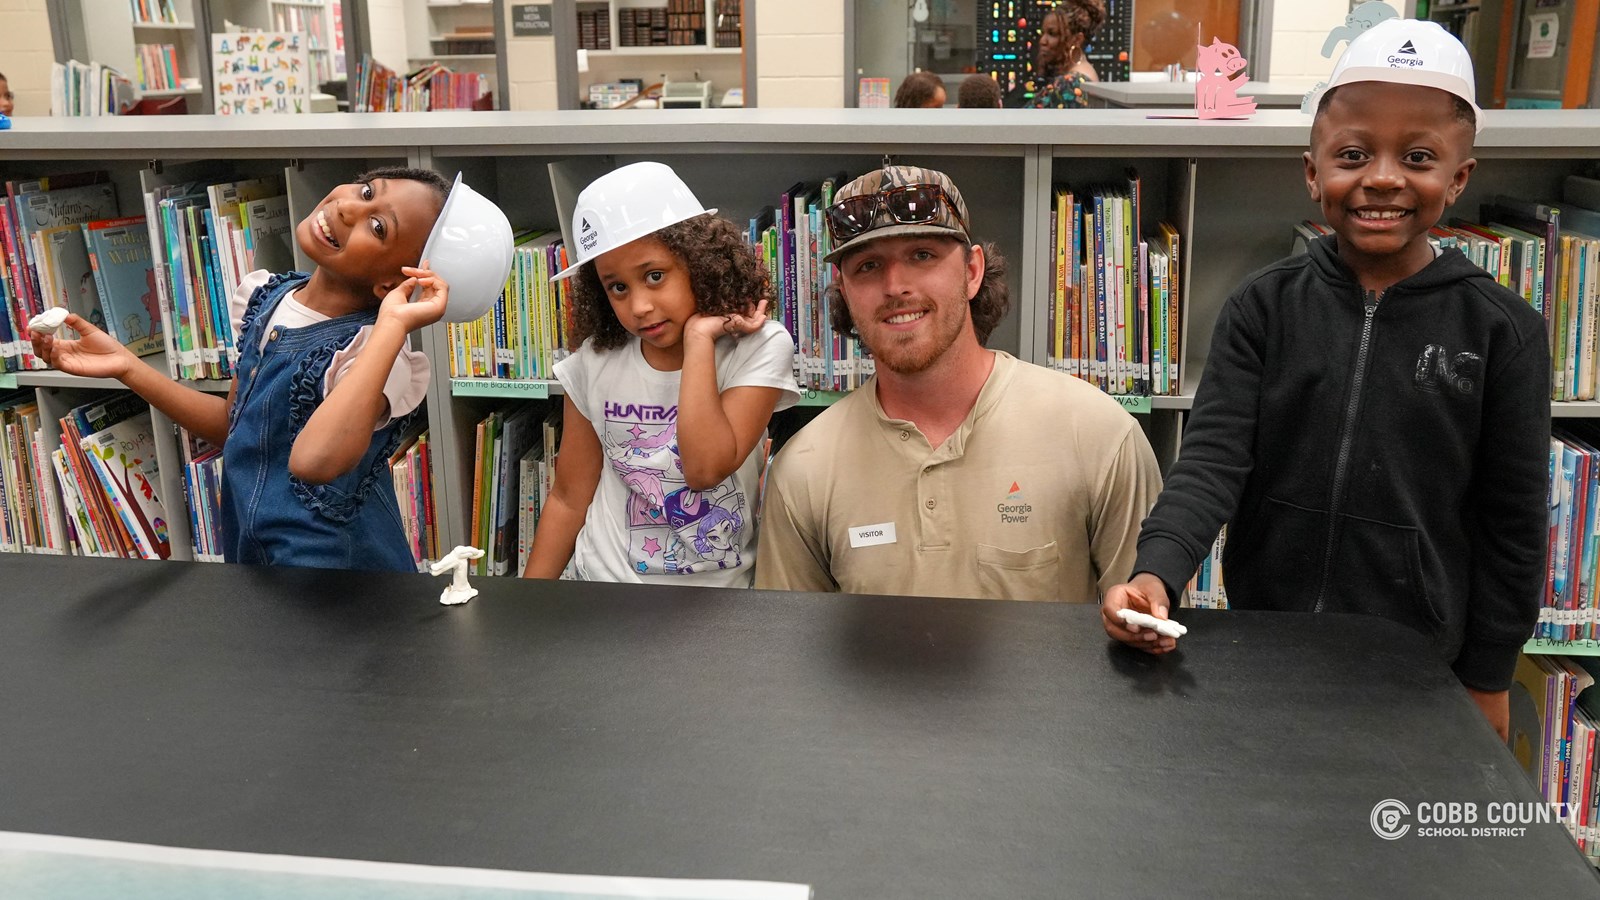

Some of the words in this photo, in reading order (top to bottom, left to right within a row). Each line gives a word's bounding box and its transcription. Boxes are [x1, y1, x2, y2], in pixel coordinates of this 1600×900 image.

[1388, 55, 1424, 66] Georgia
[580, 230, 598, 244] Georgia
[584, 240, 598, 252] Power
[514, 383, 545, 391] Lagoon
[800, 390, 817, 399] HO
[1114, 397, 1139, 406] WAS
[997, 503, 1032, 514] Georgia
[1001, 514, 1029, 523] Power
[858, 530, 884, 538] VISITOR
[1536, 638, 1542, 646] E
[1546, 639, 1574, 647] WHA
